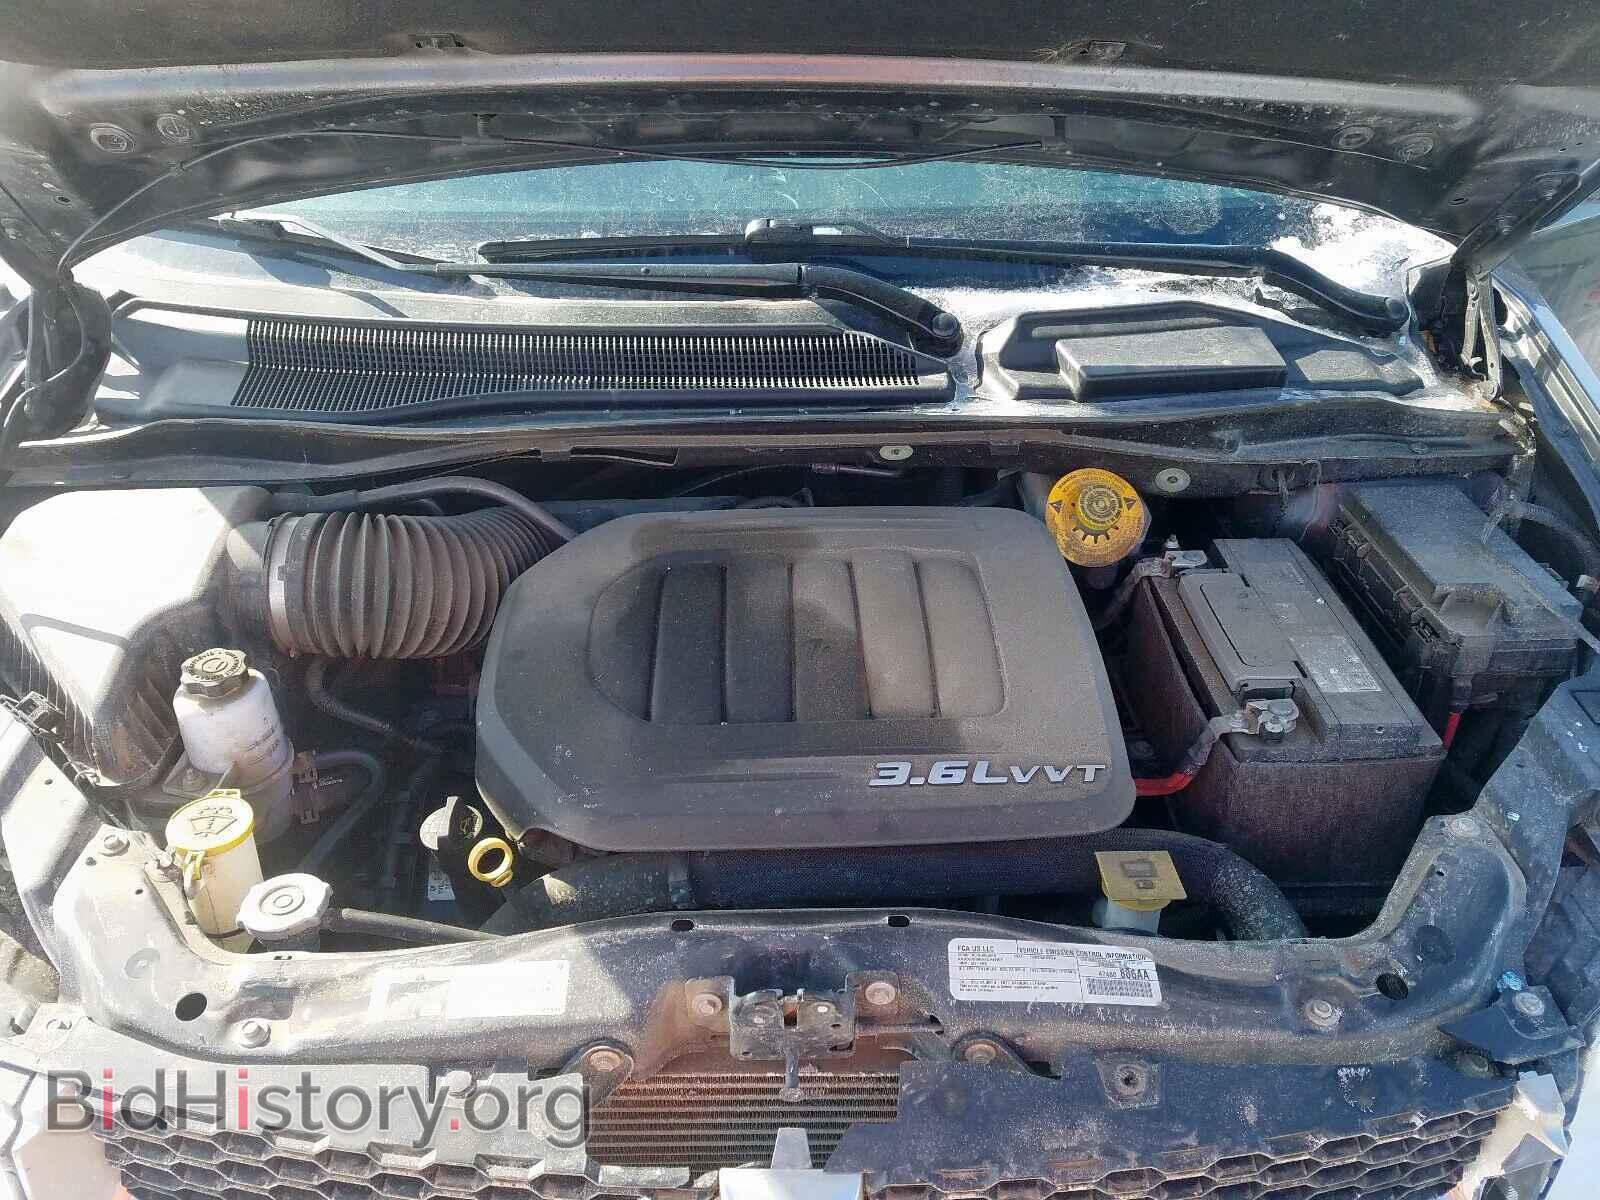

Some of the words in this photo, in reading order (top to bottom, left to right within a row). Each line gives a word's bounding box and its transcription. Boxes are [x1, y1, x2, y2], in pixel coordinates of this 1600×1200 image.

[1018, 947, 1043, 955] VEHICLE
[1044, 948, 1075, 956] EMISSION
[1076, 950, 1102, 959] CONTROL
[1105, 952, 1146, 961] INFORMATION
